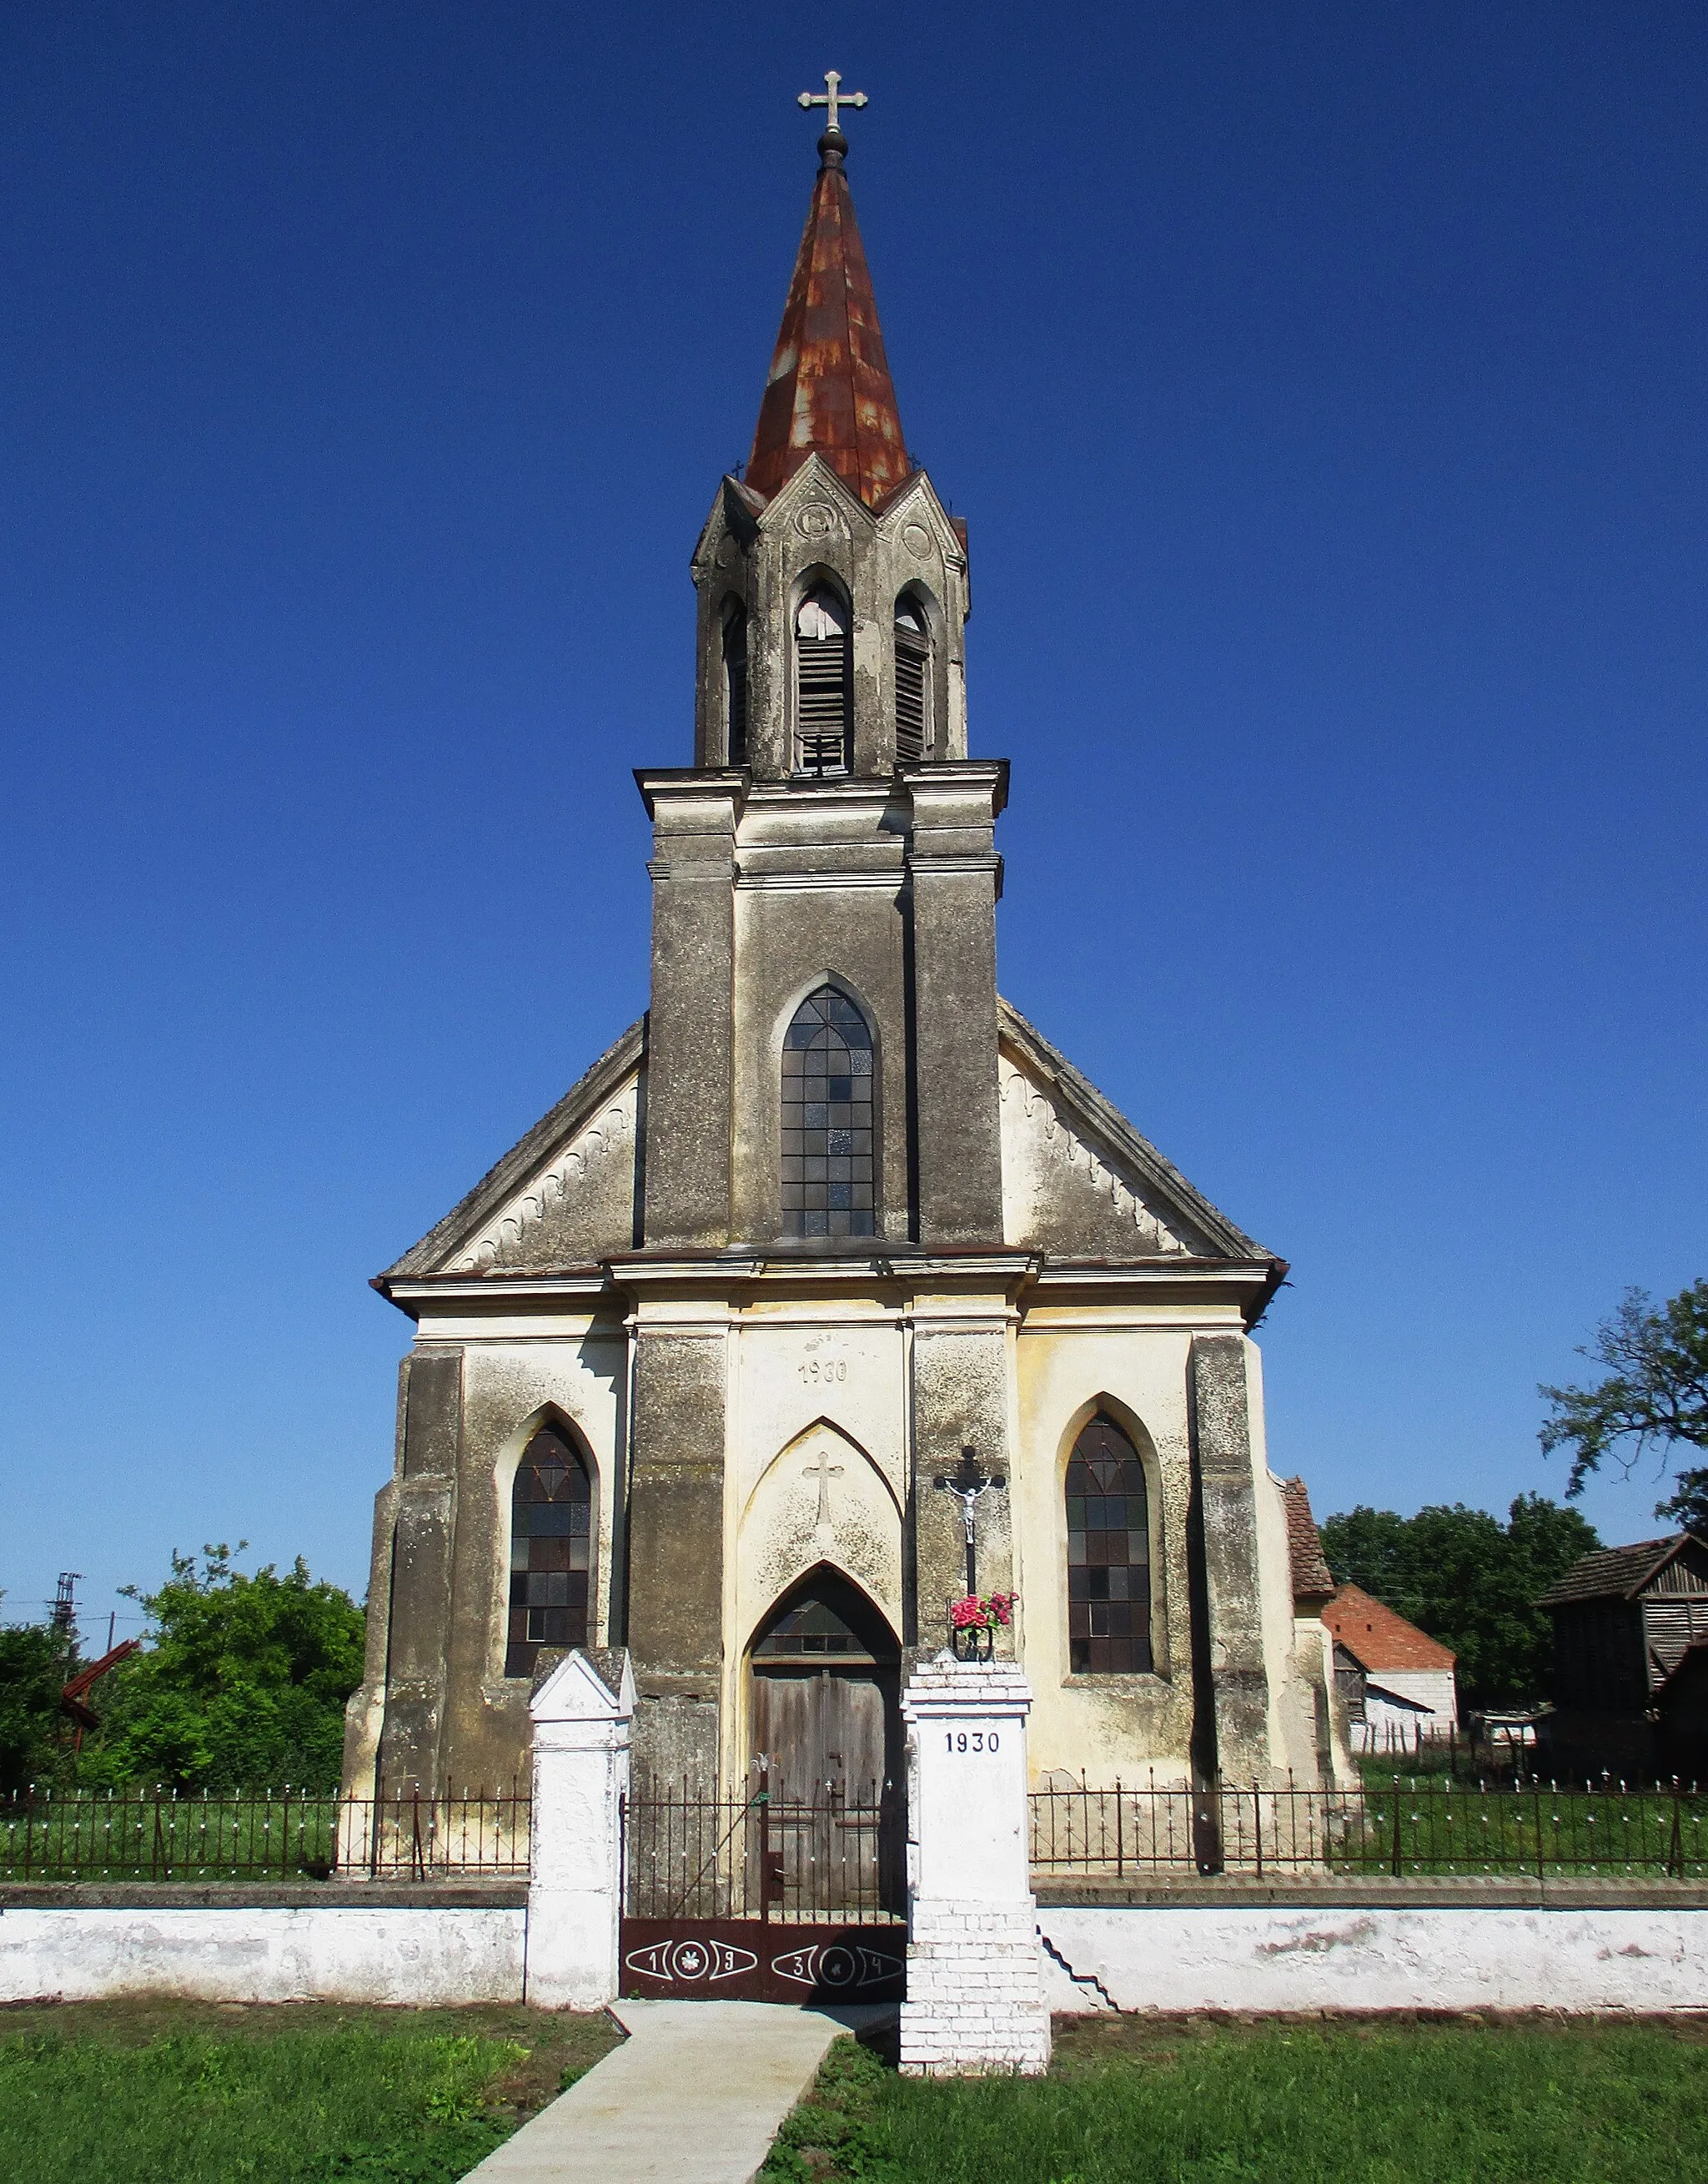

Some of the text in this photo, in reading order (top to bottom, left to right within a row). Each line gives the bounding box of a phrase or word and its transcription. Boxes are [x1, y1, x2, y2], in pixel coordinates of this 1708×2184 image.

[798, 1359, 847, 1383] 1930
[944, 1732, 1000, 1753] 1930
[649, 1951, 656, 1970] 1
[793, 1956, 804, 1975] 3
